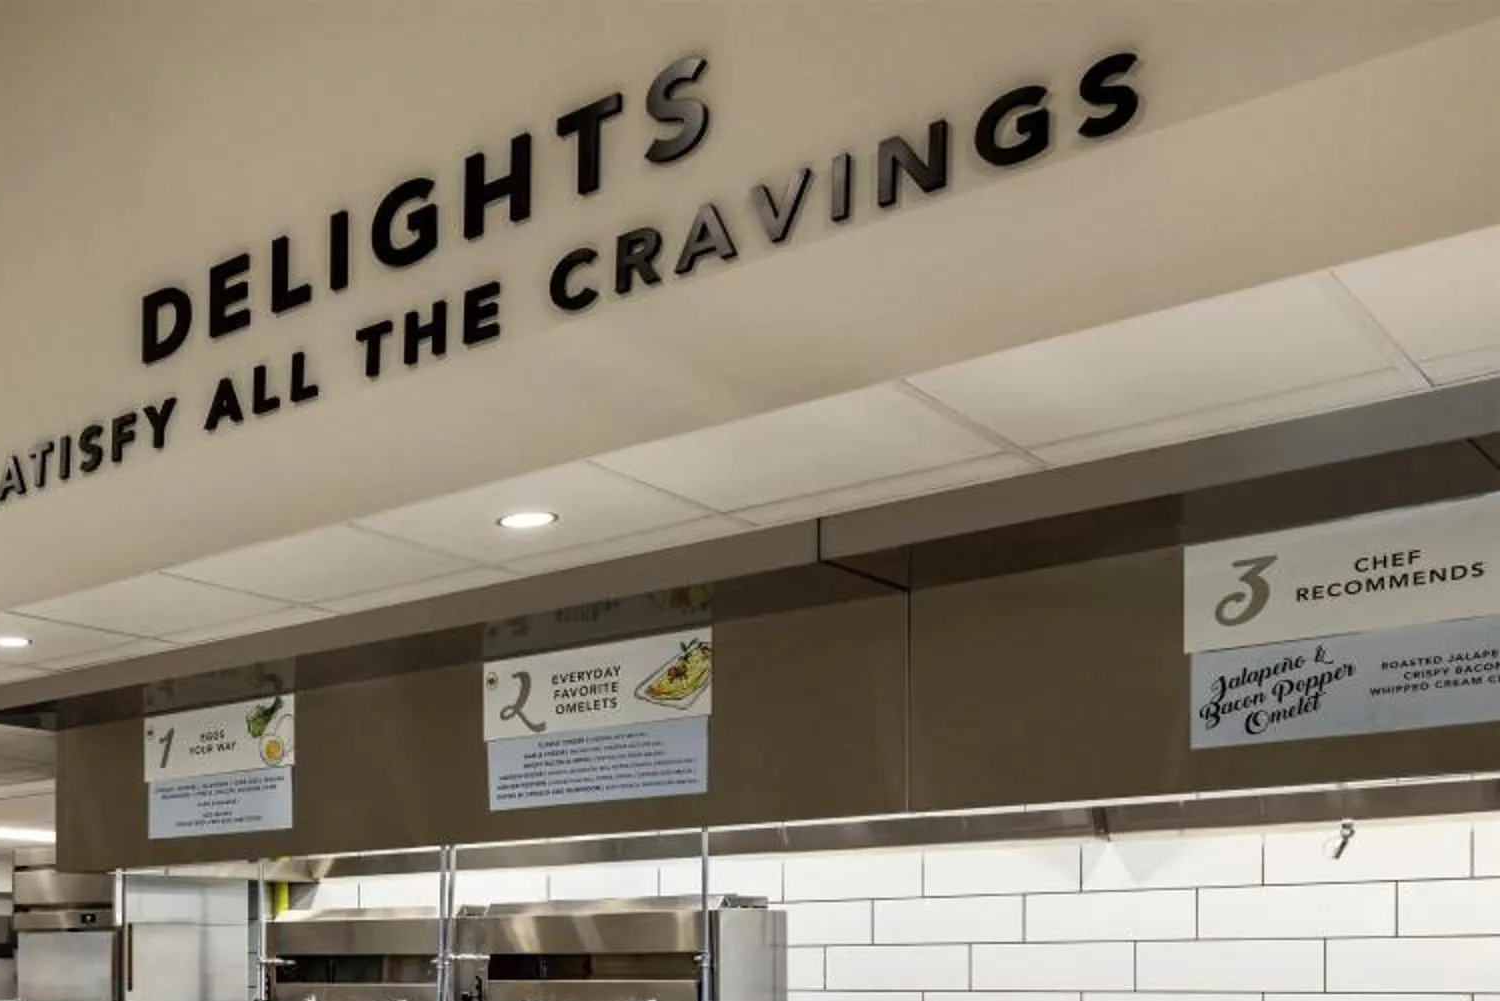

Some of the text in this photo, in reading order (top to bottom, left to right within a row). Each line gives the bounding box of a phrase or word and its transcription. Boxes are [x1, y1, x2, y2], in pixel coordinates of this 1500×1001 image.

[140, 55, 711, 364] DELIGHTS
[203, 350, 321, 433] ALL
[356, 281, 503, 378] THE
[549, 53, 1142, 312] CRAVINGS
[1295, 561, 1486, 603] RECOMMENDS
[1354, 549, 1423, 573] CHEF
[1214, 555, 1278, 627] 3
[551, 665, 621, 686] EVERYDAY
[1209, 653, 1307, 701] Jalapeño
[1380, 655, 1443, 671] ROASTED
[1403, 667, 1450, 681] CRISPY
[499, 671, 547, 732] 2
[553, 682, 619, 700] FAVORITE
[555, 697, 618, 715] OMELETS
[1199, 663, 1357, 731] Bacon Popper
[1369, 682, 1430, 697] WHIPPED
[1434, 676, 1483, 689] CREAM
[1244, 692, 1327, 735] Omelet
[159, 726, 175, 768] 1
